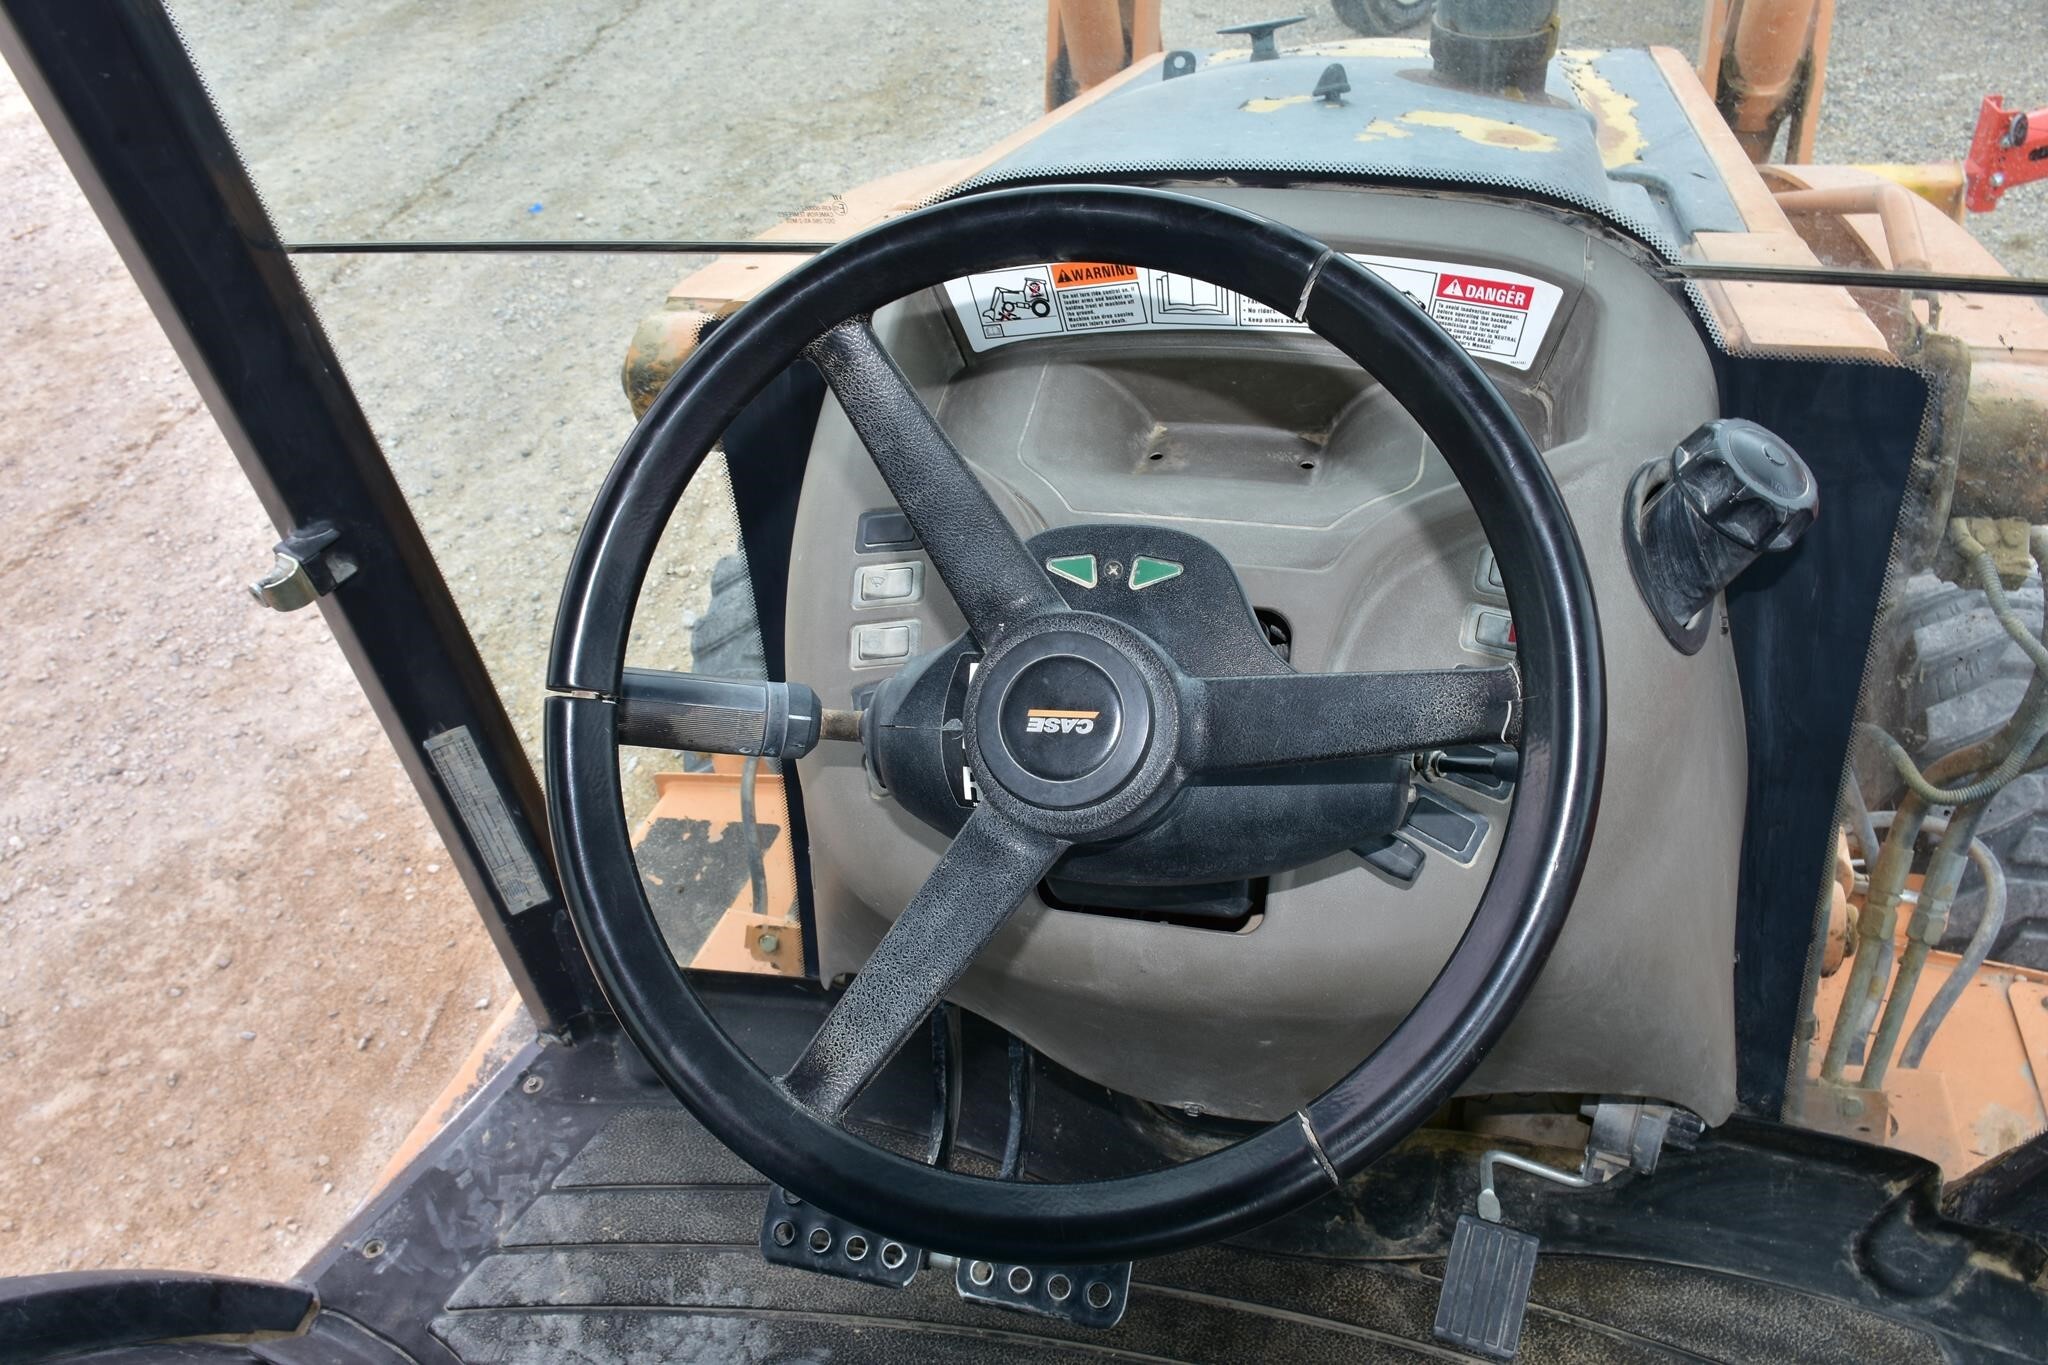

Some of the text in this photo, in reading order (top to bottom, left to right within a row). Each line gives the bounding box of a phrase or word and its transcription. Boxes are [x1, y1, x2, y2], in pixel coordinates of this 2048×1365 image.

[1071, 265, 1134, 281] WARNING
[1465, 284, 1526, 306] DANGER
[1455, 312, 1479, 320] operating
[1461, 307, 1490, 315] inadvertent
[1494, 334, 1516, 342] NEUTRAL
[1026, 717, 1094, 734] CASE
